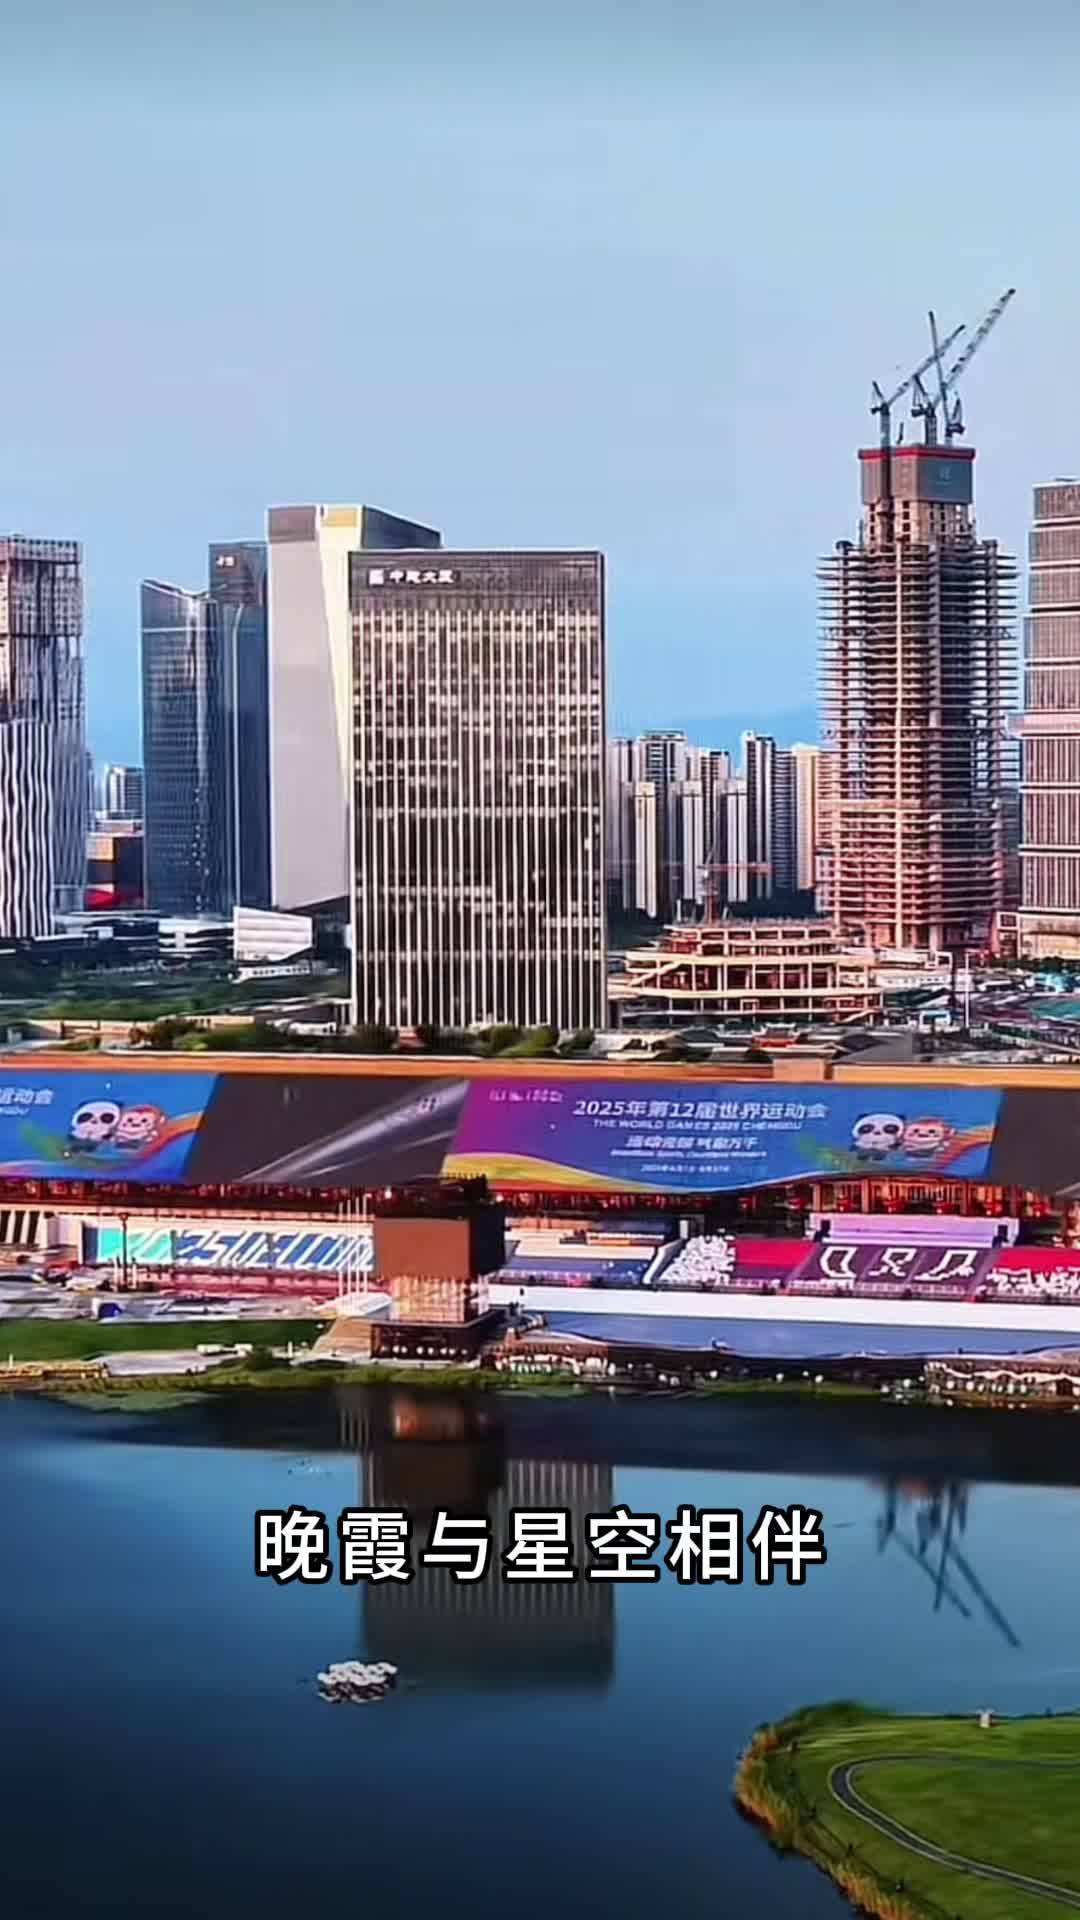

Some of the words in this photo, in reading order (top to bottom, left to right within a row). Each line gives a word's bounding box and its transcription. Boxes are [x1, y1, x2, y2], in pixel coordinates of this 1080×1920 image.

[572, 1100, 830, 1120] 2025年第12届世界运动会
